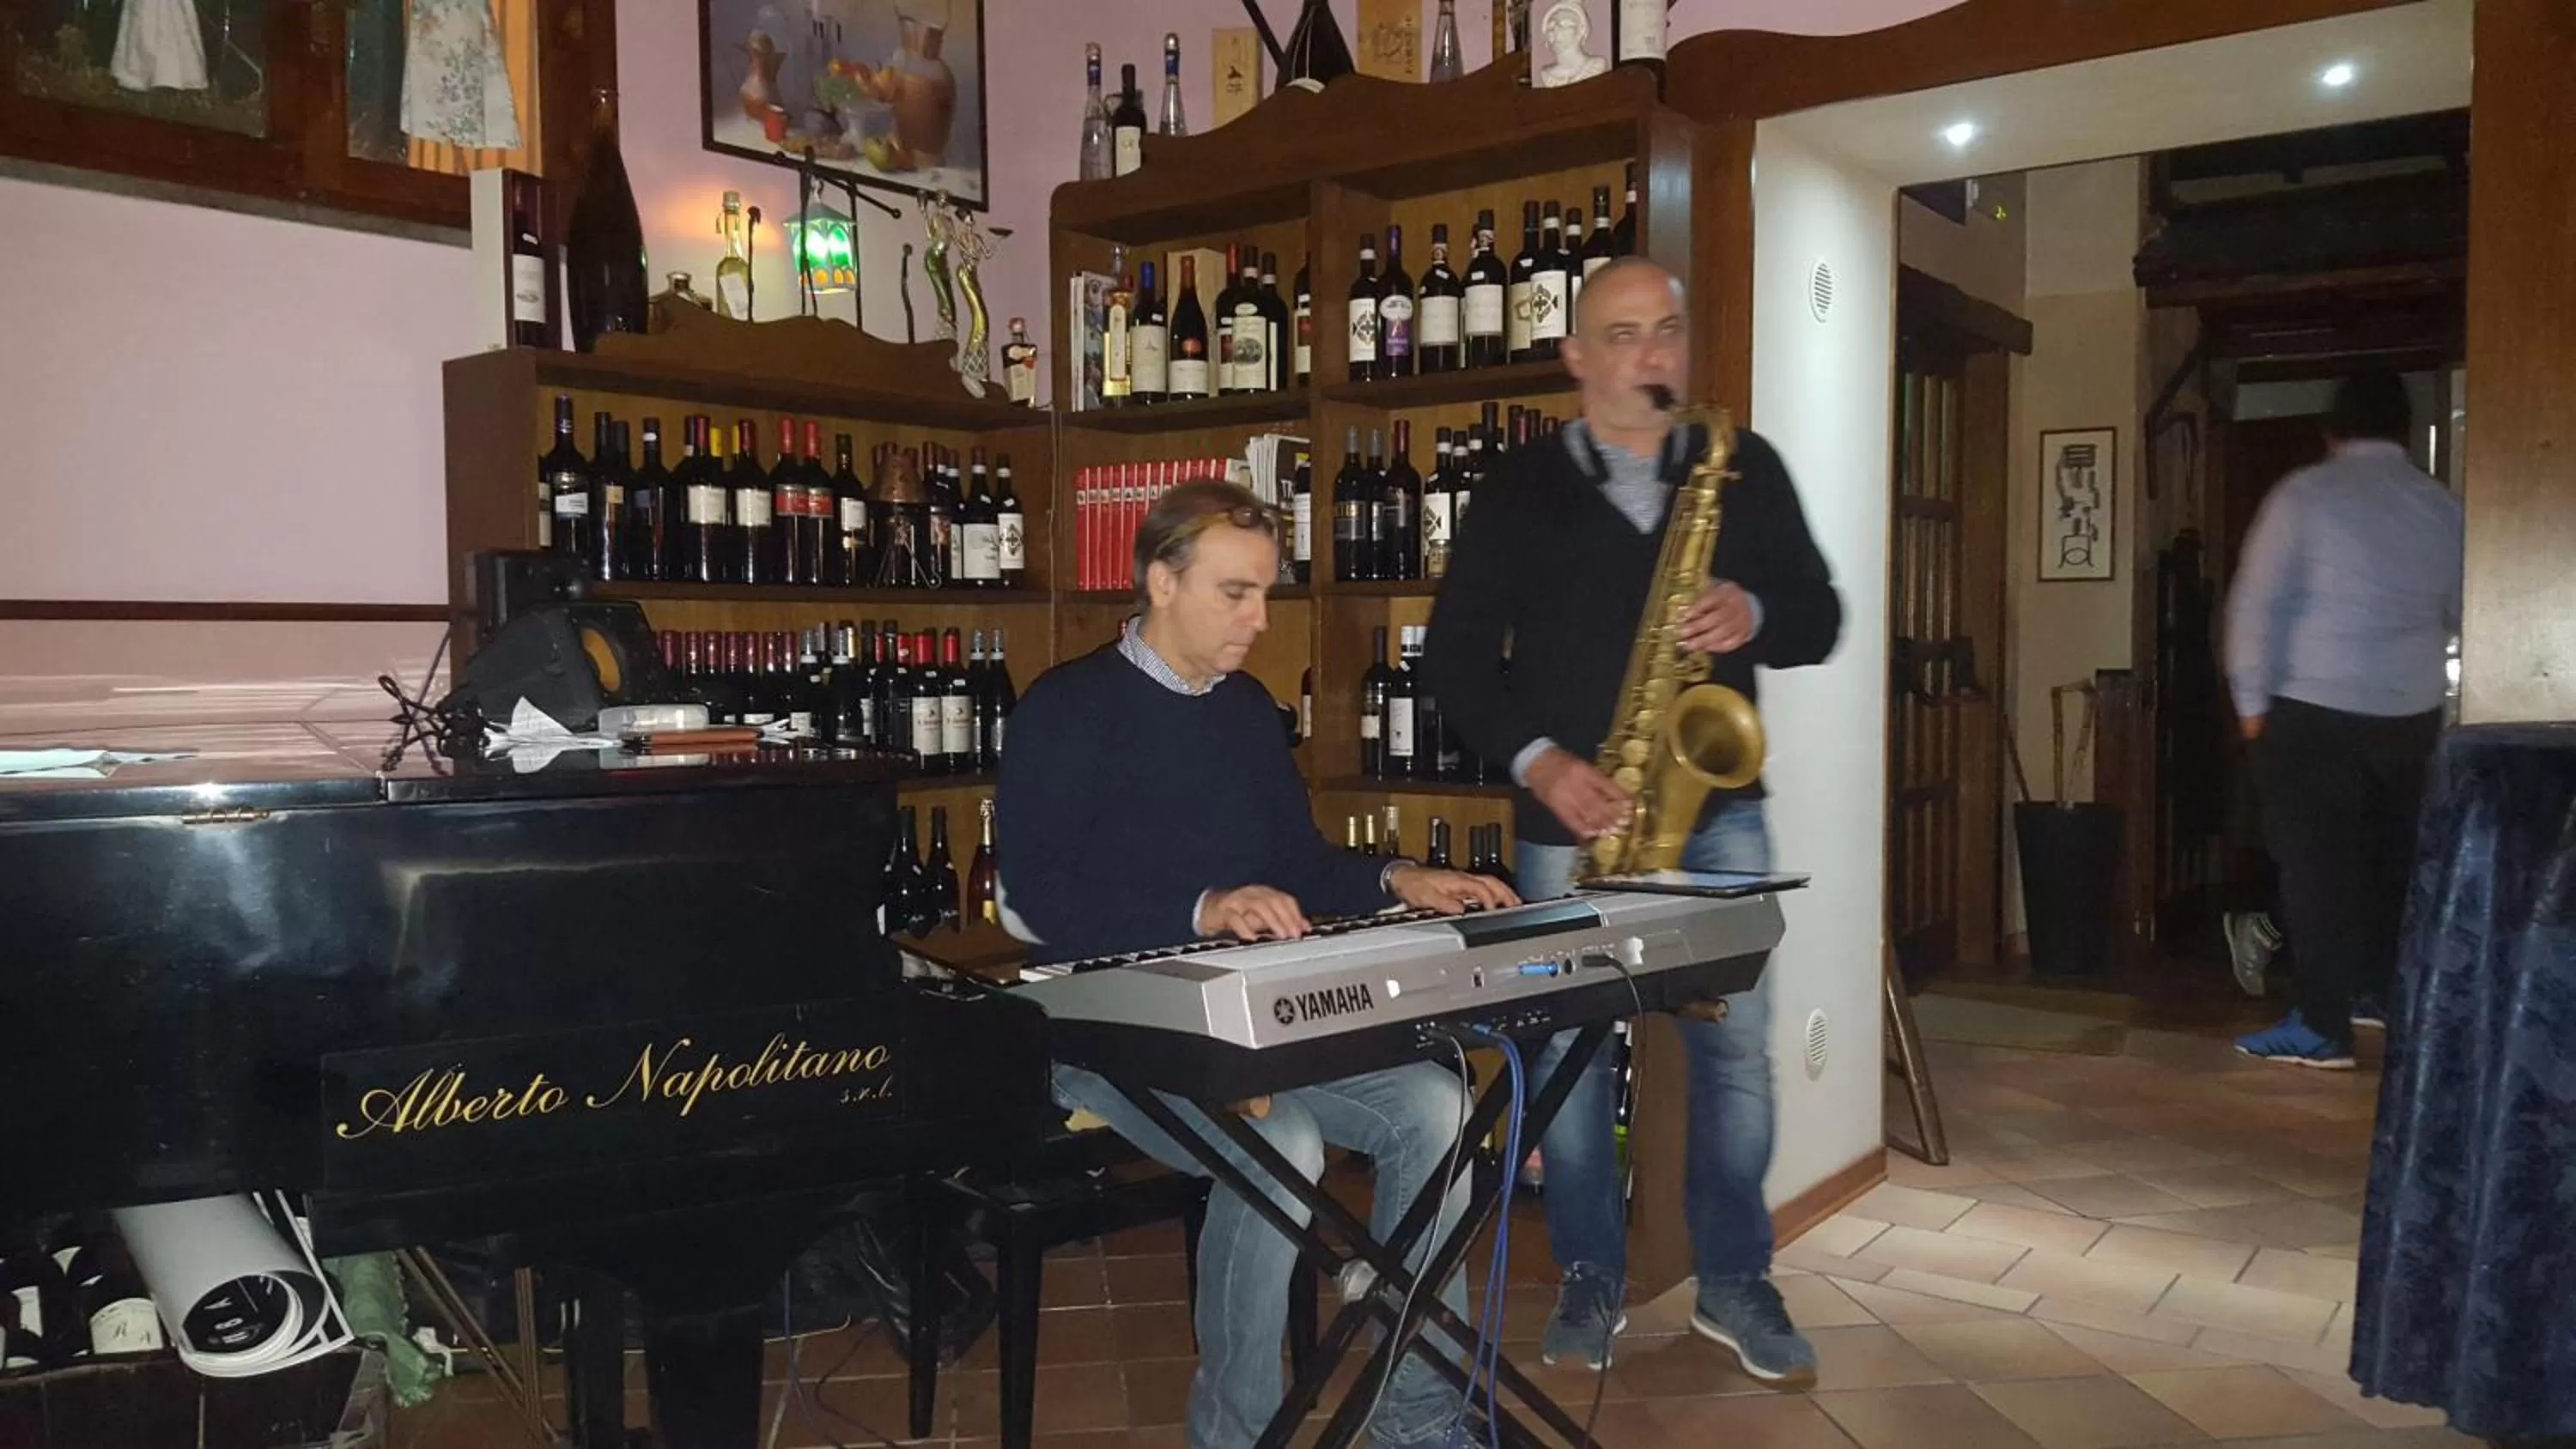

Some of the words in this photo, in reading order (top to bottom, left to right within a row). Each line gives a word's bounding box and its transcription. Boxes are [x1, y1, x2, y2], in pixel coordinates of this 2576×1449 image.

[1295, 983, 1375, 1022] YAMAHA
[336, 1068, 570, 1139] Alberto
[586, 1032, 891, 1117] Napolitano
